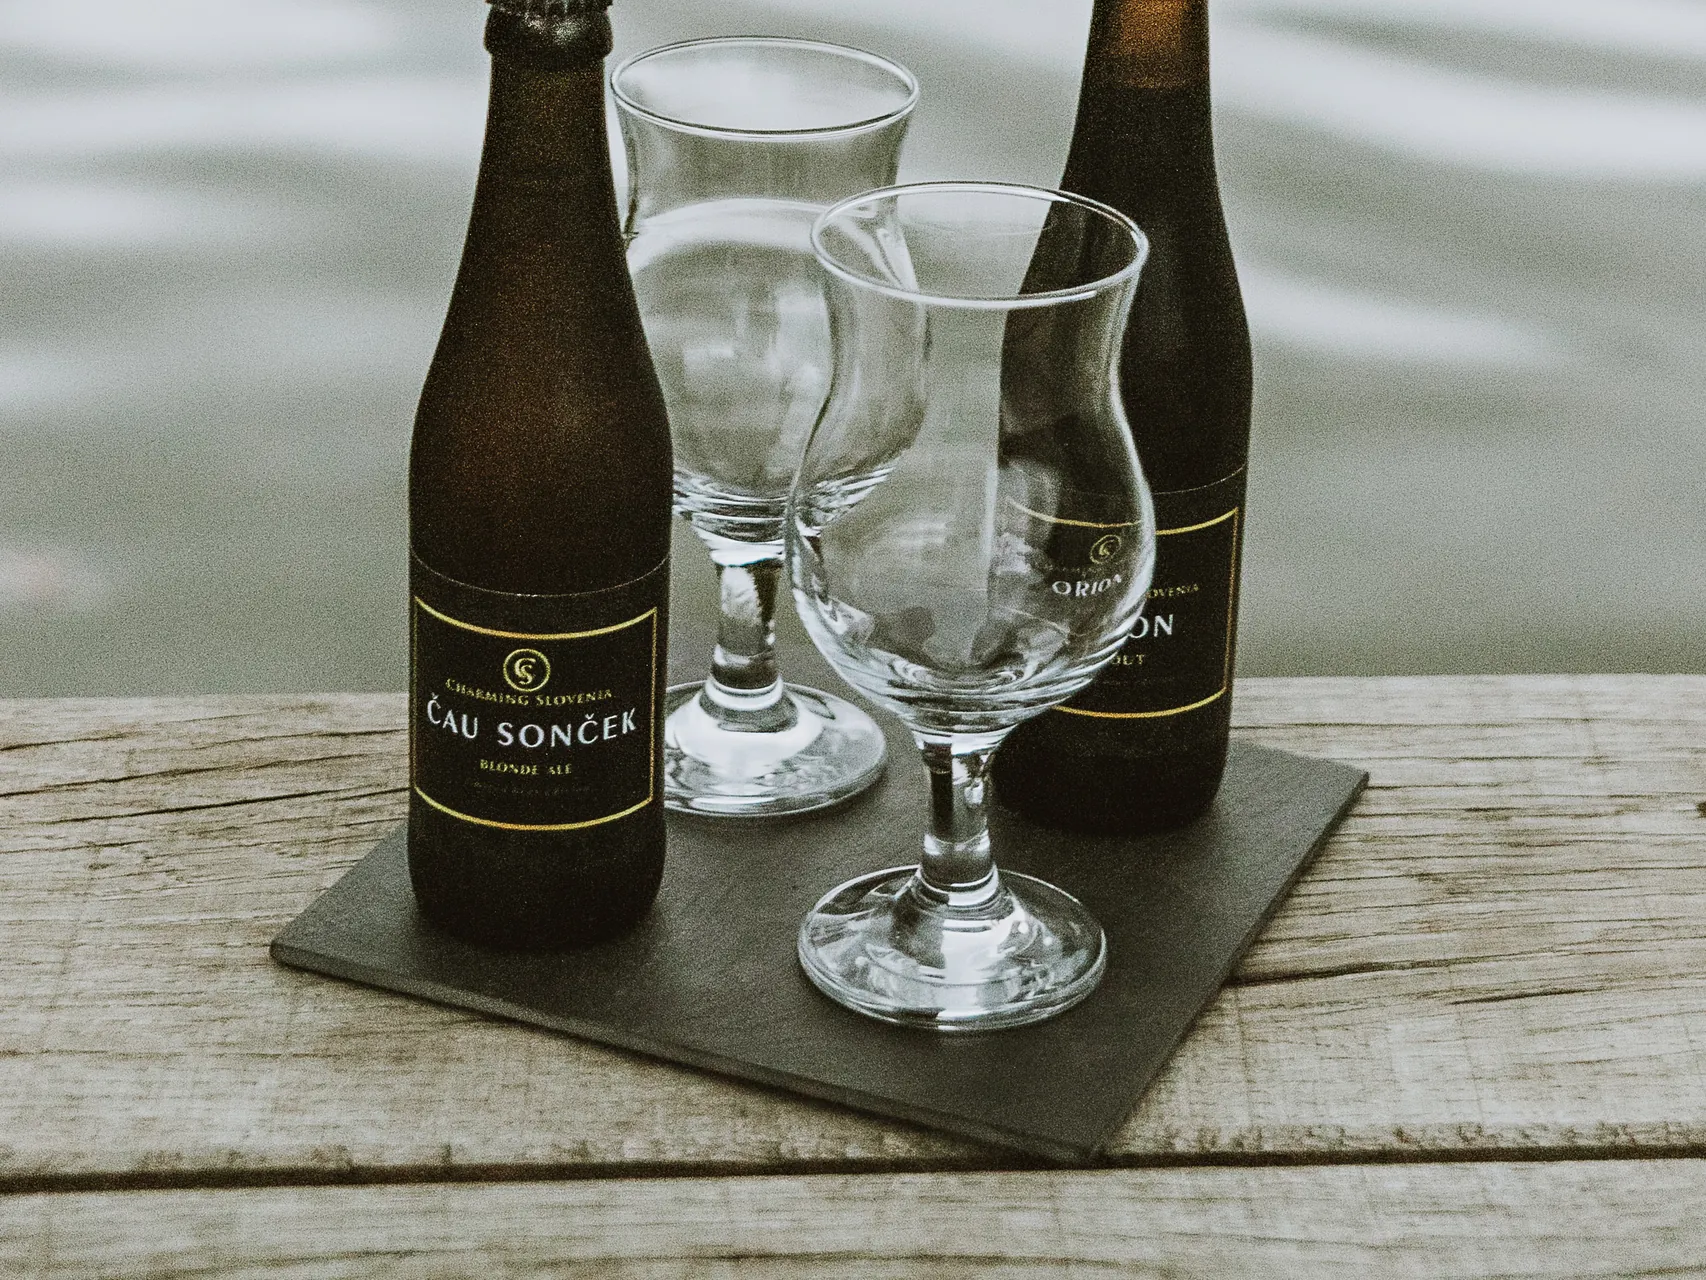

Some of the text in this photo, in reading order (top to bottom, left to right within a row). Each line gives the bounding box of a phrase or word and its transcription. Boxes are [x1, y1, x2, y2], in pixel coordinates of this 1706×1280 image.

[445, 678, 612, 706] CHARMING SLOVENIA
[427, 692, 637, 748] ČAU SONČEK
[480, 759, 573, 775] BLONDE ALE
